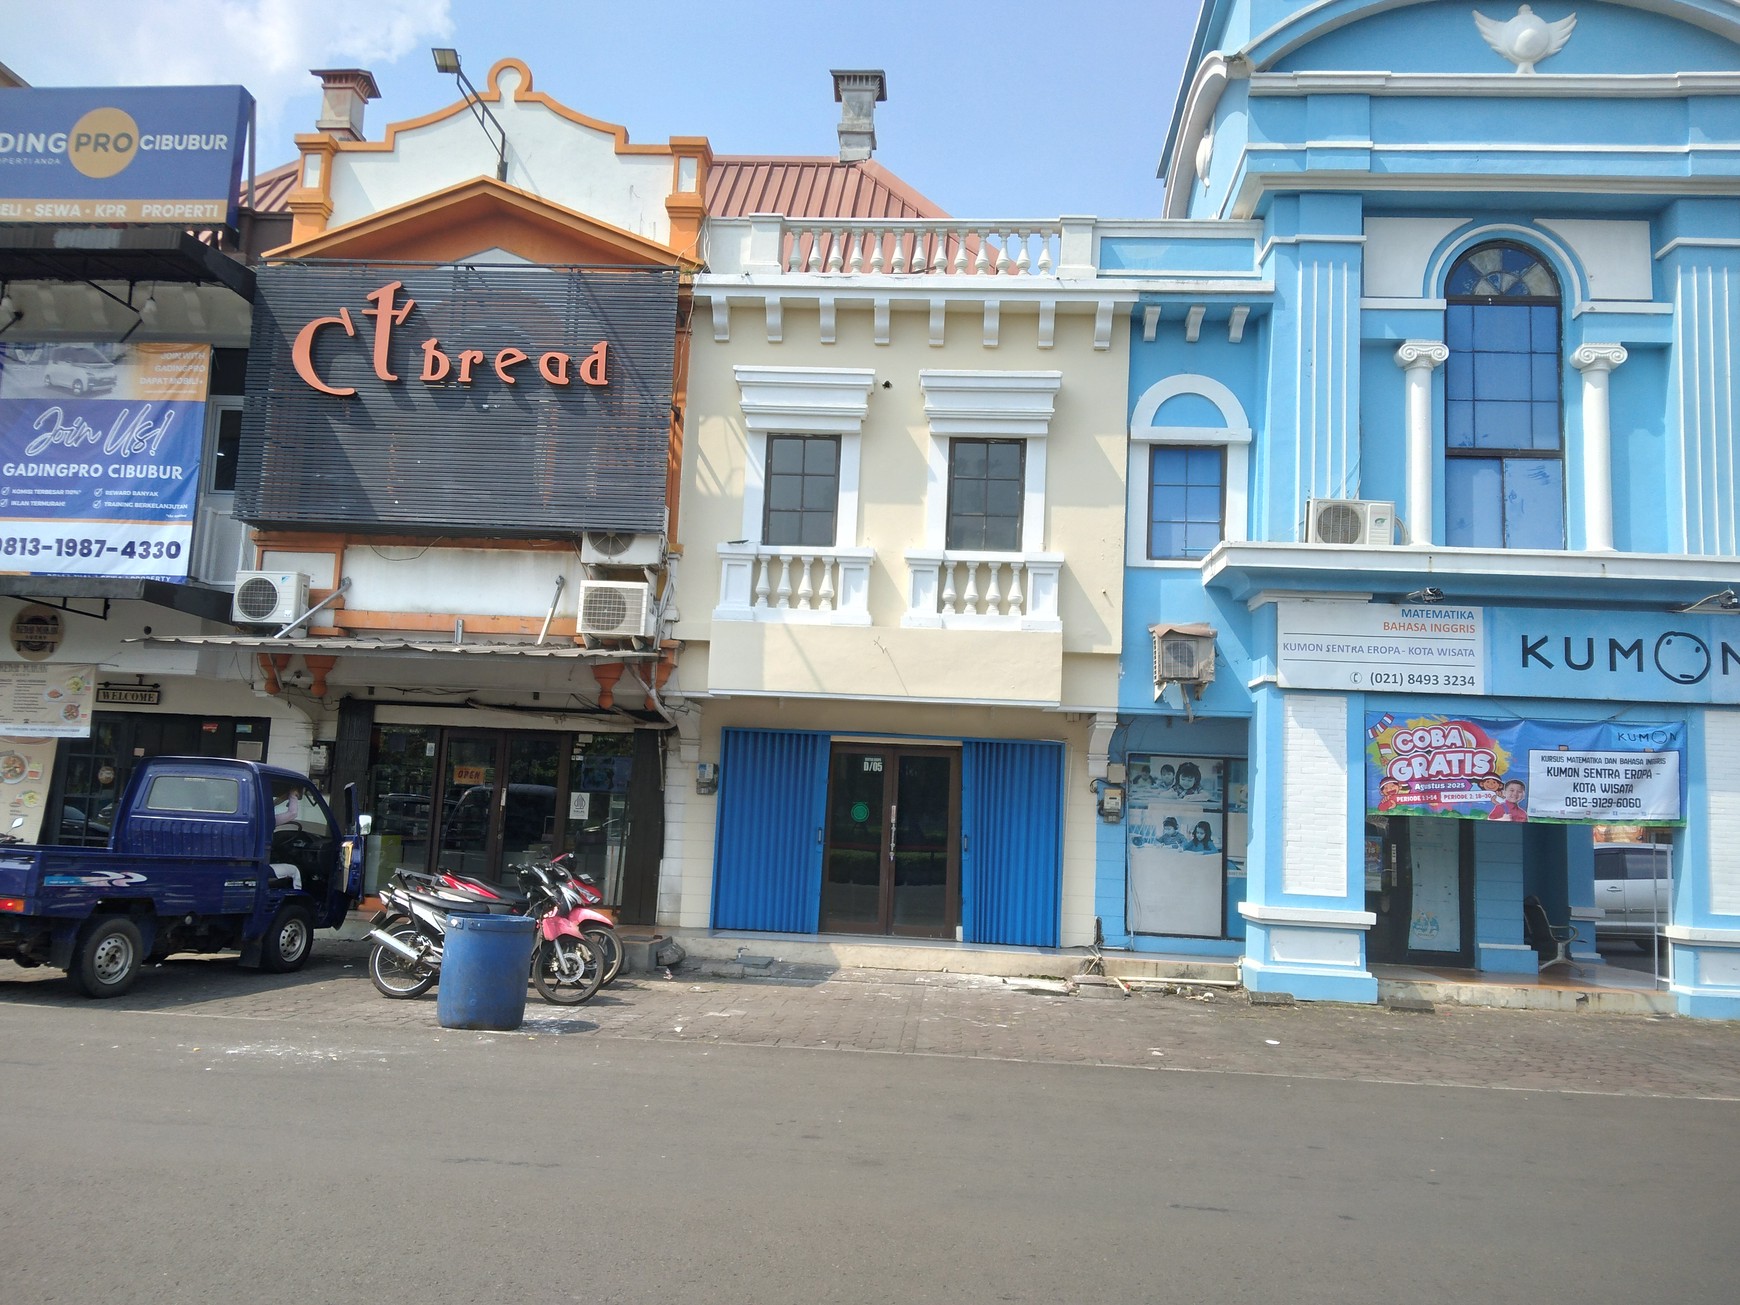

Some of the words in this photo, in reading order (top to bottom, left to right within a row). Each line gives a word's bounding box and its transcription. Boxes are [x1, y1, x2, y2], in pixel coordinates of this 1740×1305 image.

[75, 132, 133, 153] PRO
[140, 134, 228, 151] CIBUBUR
[0, 204, 21, 216] ELI
[34, 204, 81, 217] SEWA
[94, 204, 127, 217] KPR
[141, 204, 218, 218] PROPERTI
[154, 364, 206, 372] GADINGPRO
[419, 337, 609, 386] bread
[139, 377, 168, 385] DAPAT
[25, 406, 102, 456] Join
[103, 403, 175, 457] Us!
[2, 463, 103, 478] GADINGPRO
[108, 464, 183, 480] CIBUBUR
[134, 502, 188, 510] BERKELANJUTAN
[0, 537, 181, 559] 813-1987-4330
[1401, 608, 1475, 620] MATEMATIKA
[1383, 621, 1427, 632] BAHASA
[1430, 622, 1476, 634] INGGRIS
[1283, 642, 1323, 652] KUMON
[1325, 644, 1364, 654] SENTRA
[1408, 647, 1434, 656] KOTA
[1437, 647, 1475, 657] WISATA
[1521, 630, 1740, 685] KUMON
[1370, 671, 1403, 687] (021)
[1407, 673, 1440, 686] 8493
[1443, 674, 1475, 687] 3234
[102, 691, 155, 702] WELCOME
[1395, 728, 1463, 752] COBA
[1617, 730, 1678, 744] KUMON
[863, 761, 883, 772] D/05
[1541, 755, 1564, 763] KURSUS
[1566, 756, 1602, 764] MATEMATIKA
[1620, 757, 1644, 765] BAHASA
[1391, 752, 1492, 782] GRATIS
[1546, 766, 1580, 778] KUMON
[1583, 767, 1620, 779] SENTRA
[1624, 768, 1652, 779] EROPA
[458, 770, 481, 780] OPEN
[1572, 782, 1597, 793] KOTA
[1600, 783, 1634, 794] WISATA
[1396, 795, 1421, 803] PERIODE
[1444, 792, 1467, 800] PERIODE
[1565, 797, 1642, 809] 0812-9129-6060
